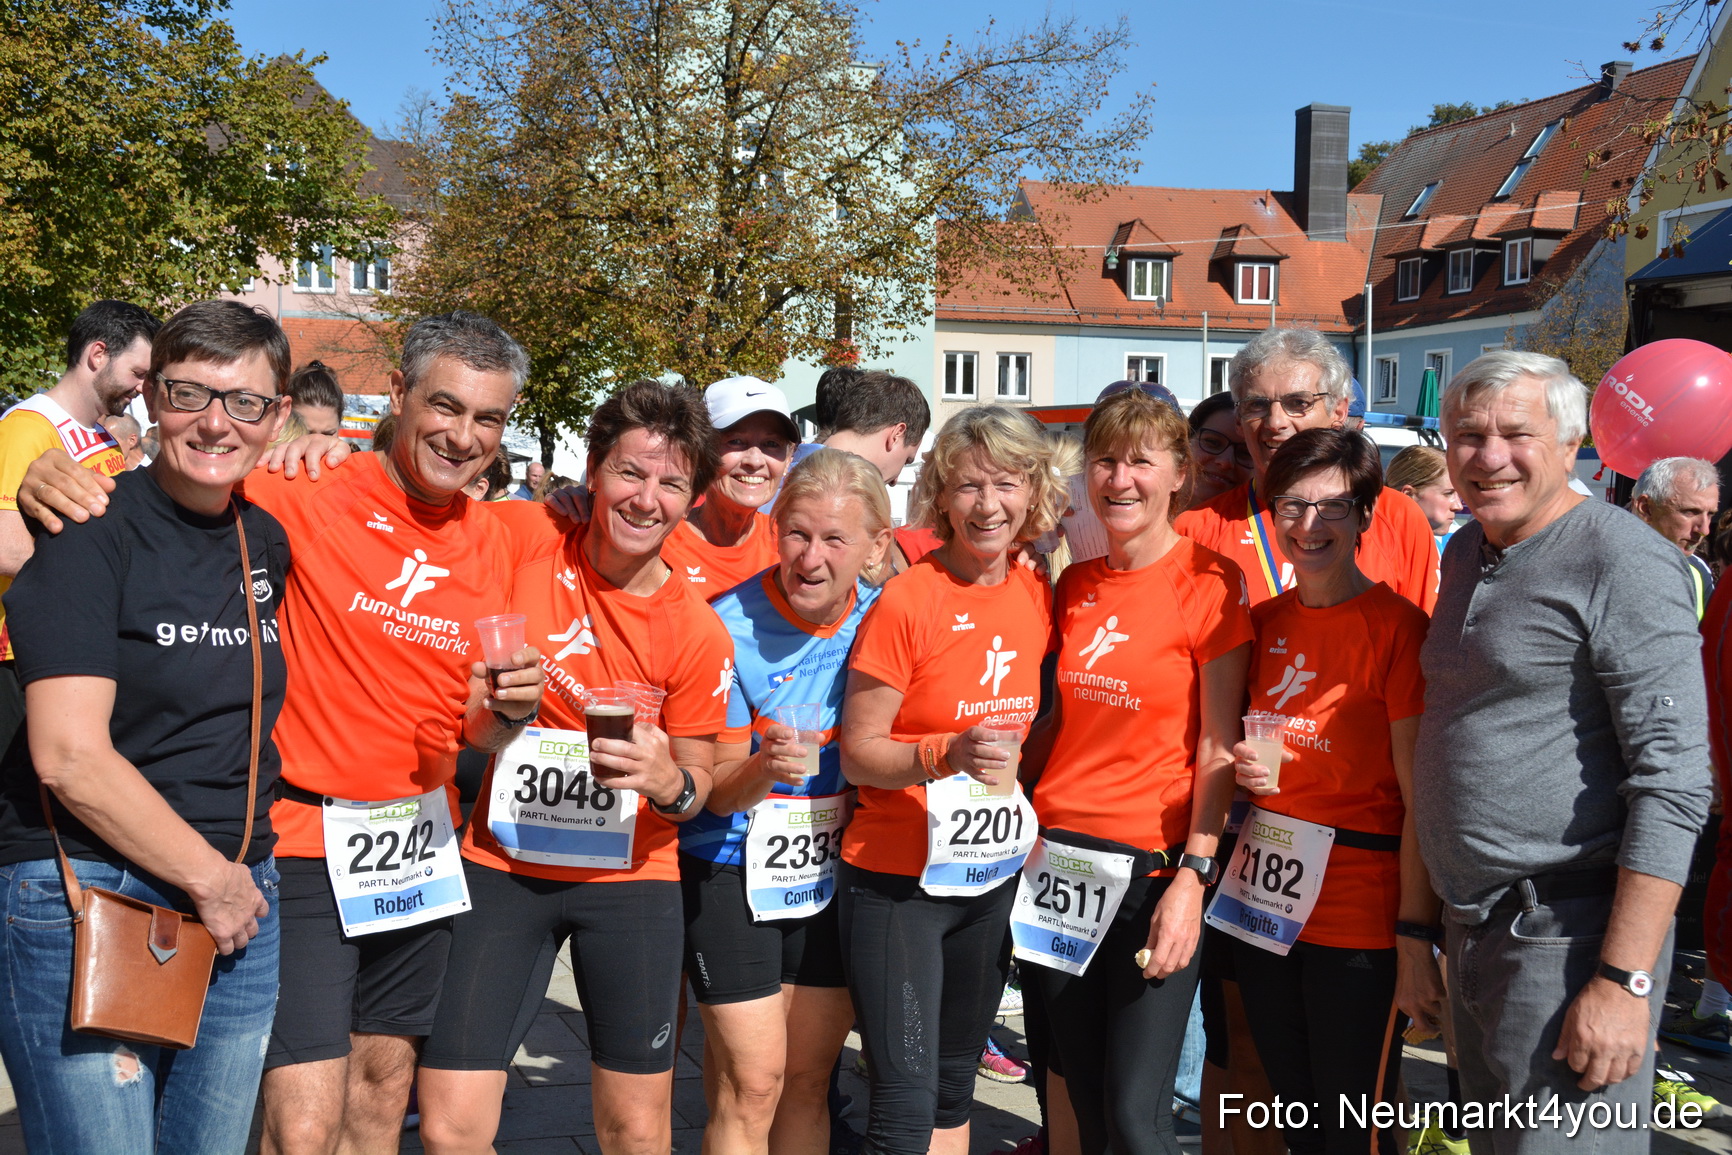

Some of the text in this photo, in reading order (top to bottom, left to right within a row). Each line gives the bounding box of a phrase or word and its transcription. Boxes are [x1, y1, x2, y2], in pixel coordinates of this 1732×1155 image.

[1620, 401, 1649, 427] energie
[366, 520, 394, 533] erima
[348, 592, 460, 635] funrunners
[156, 618, 279, 646] getmoin'
[382, 621, 471, 655] neumarkt
[951, 622, 976, 632] erima
[1058, 667, 1128, 693] funrunners
[954, 696, 1034, 720] funrunners
[1073, 687, 1142, 711] neumarkt
[514, 764, 616, 811] 3048
[369, 799, 422, 820] BOCK
[520, 810, 592, 825] PARTL Neumarkt
[788, 807, 839, 825] BOCK
[949, 804, 1023, 845] 2201
[1252, 821, 1295, 846] BOCK
[347, 819, 436, 875] 2242
[952, 849, 1011, 858] PARTL Neumarkt
[771, 868, 829, 883] PARTL Neumarkt
[1049, 852, 1094, 875] BOCK
[1239, 843, 1304, 900] 2182
[358, 871, 423, 889] PARTL Neumarkt
[374, 889, 425, 916] Robert
[784, 886, 824, 906] Conny
[1034, 871, 1106, 923] 2511
[1239, 887, 1283, 910] PARTL Neumarkt
[1038, 914, 1090, 935] PARTL Neumarkt
[1239, 907, 1279, 936] Brigitte
[1051, 936, 1079, 957] Gabi
[696, 952, 710, 981] CRAFT
